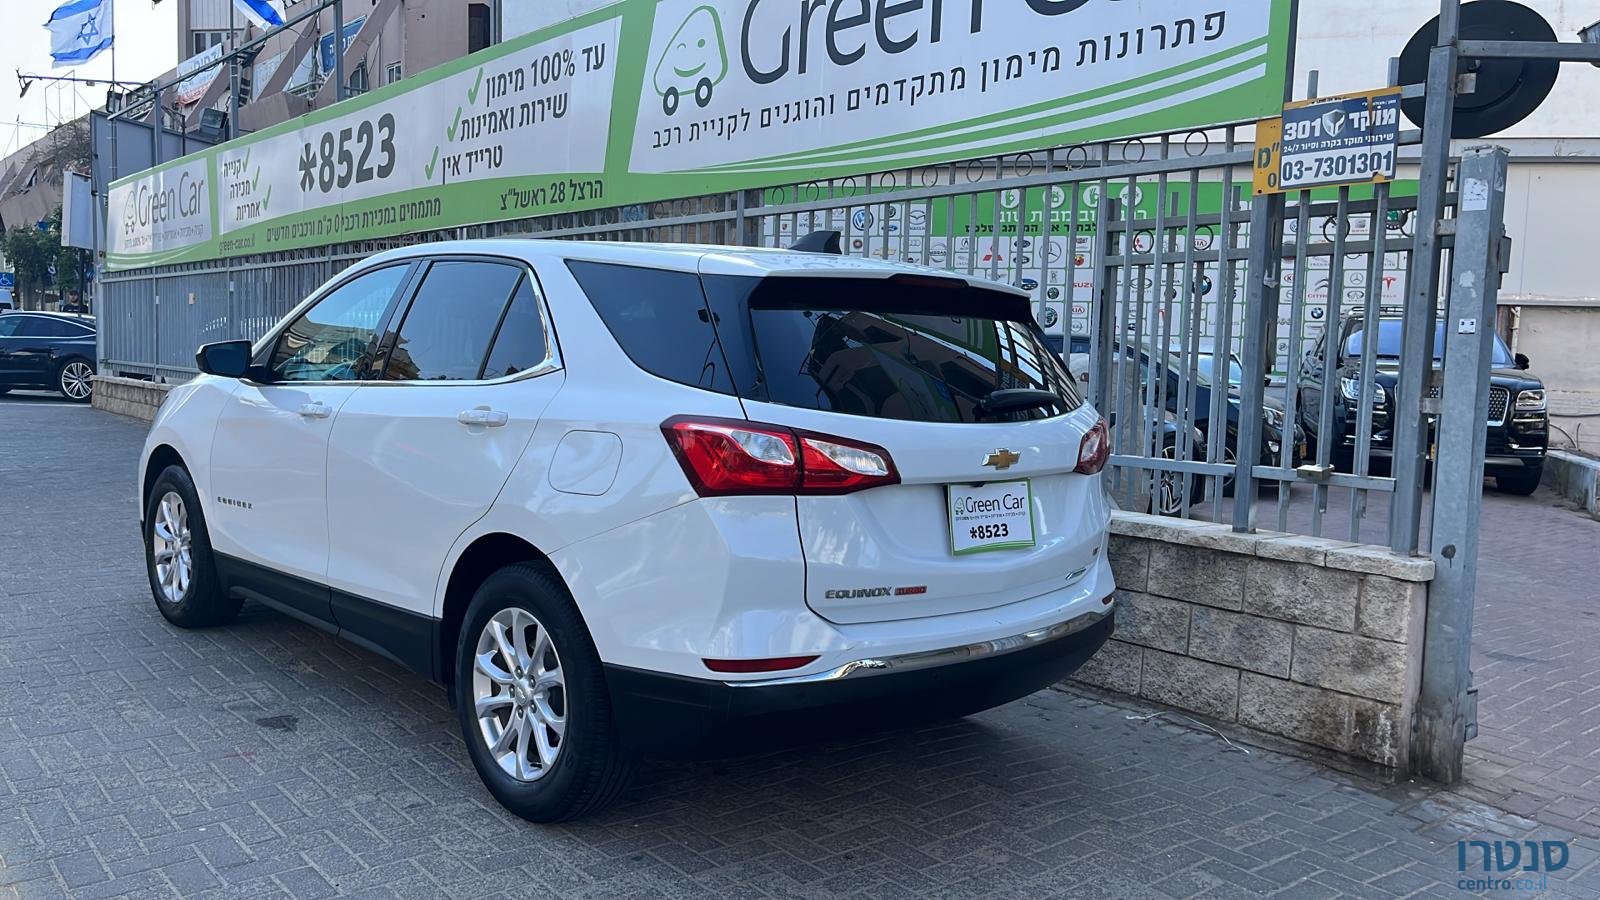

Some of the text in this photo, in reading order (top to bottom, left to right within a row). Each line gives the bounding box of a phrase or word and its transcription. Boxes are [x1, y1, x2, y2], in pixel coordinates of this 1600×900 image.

[486, 43, 606, 107] עד 100% מימון
[653, 11, 1226, 149] פתרונות מימון מתקדמים והוגנים לקניית רכב
[460, 92, 568, 142] שירות ואמינות
[1283, 117, 1322, 141] 301
[1283, 144, 1300, 153] 24/7
[1320, 139, 1342, 149] בקרה
[1343, 136, 1363, 146] מוקד
[223, 158, 242, 178] קנייה
[441, 145, 504, 184] טרייד אין
[1282, 150, 1393, 182] 03-7301301
[138, 171, 204, 227] Green Car
[229, 179, 251, 200] מכירה
[500, 178, 603, 211] הרצל 28 ראשל"צ
[236, 199, 261, 221] אחריות
[362, 206, 396, 228] במכירת
[399, 196, 441, 220] מתמחים
[1030, 210, 1071, 222] מבת
[267, 224, 289, 242] חדשים
[291, 220, 317, 239] ורכבים
[317, 216, 333, 237] ק"מ
[965, 493, 1025, 514] Green Car
[825, 586, 893, 599] EQUINOX
